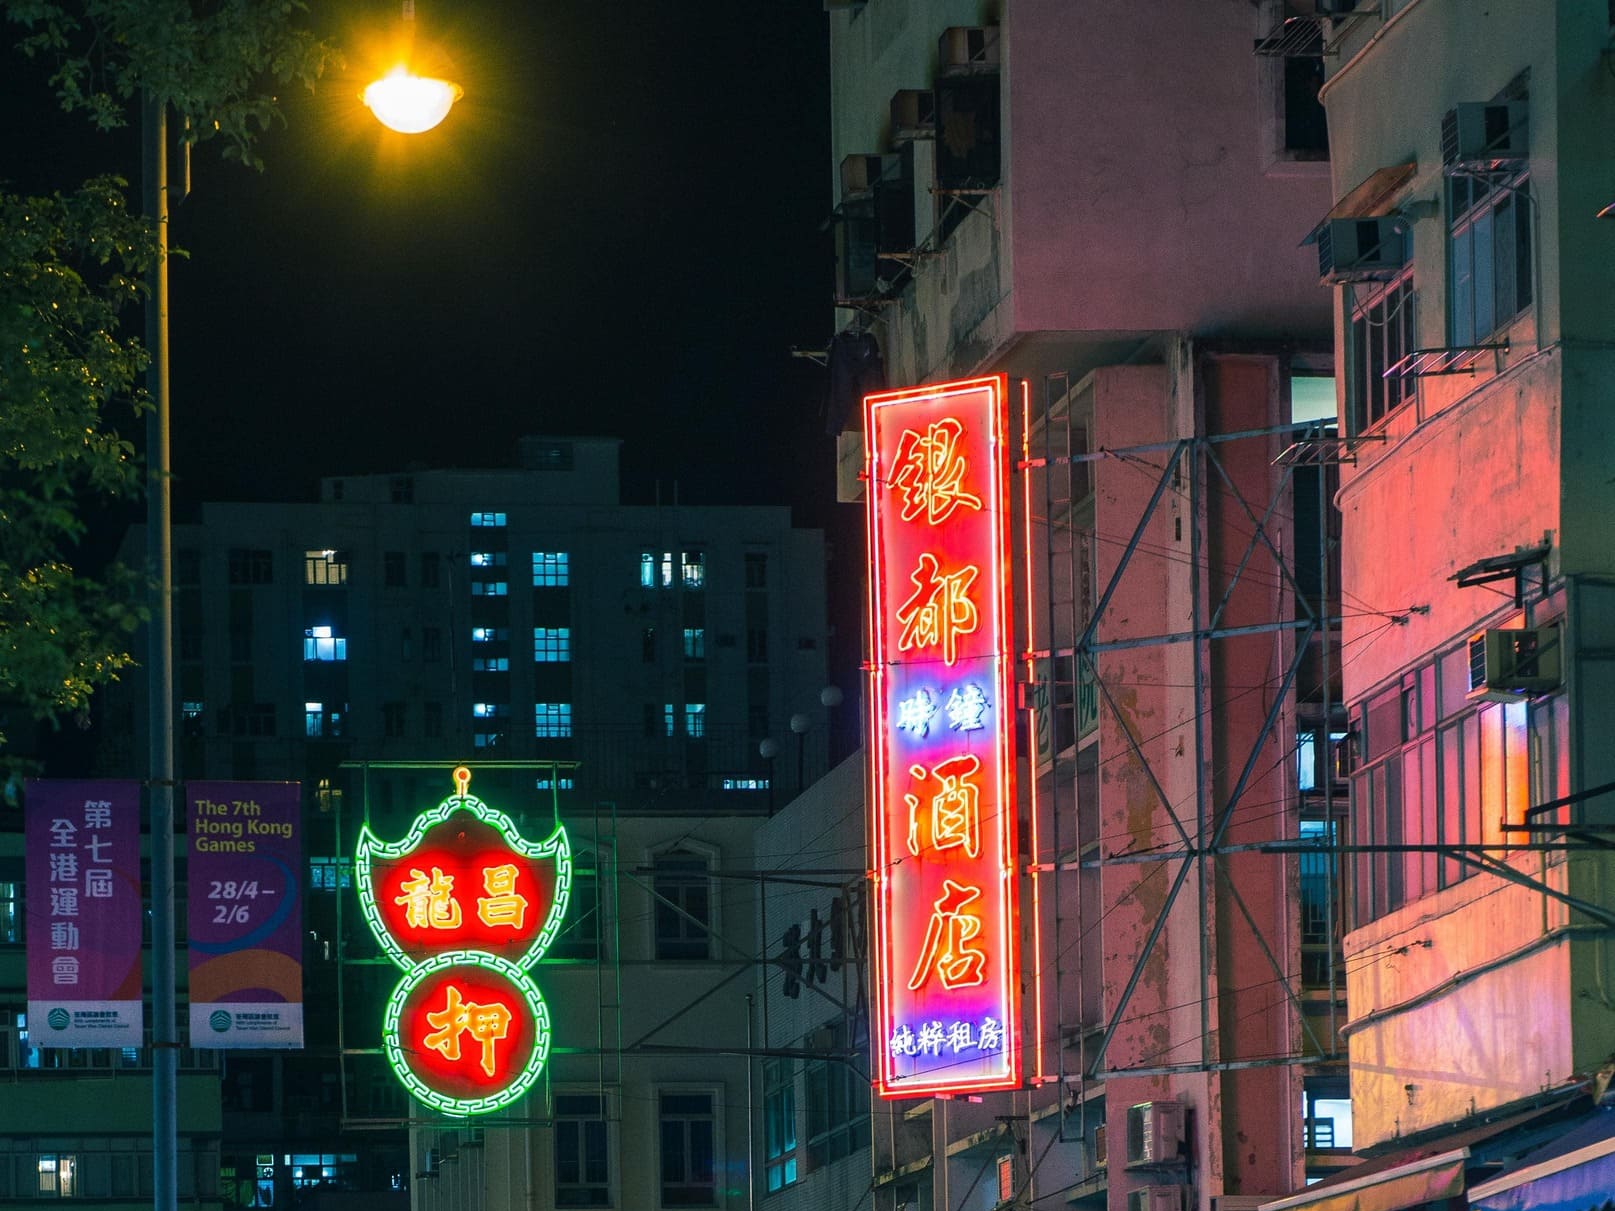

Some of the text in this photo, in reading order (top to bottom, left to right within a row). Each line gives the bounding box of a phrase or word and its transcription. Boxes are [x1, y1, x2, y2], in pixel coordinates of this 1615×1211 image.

[195, 800, 262, 816] The 7th
[195, 819, 293, 839] Hong Kong
[84, 799, 114, 899] 第七屆
[195, 837, 256, 852] Games
[49, 818, 79, 985] 全港運動會
[213, 904, 250, 924] 2/6
[425, 984, 512, 1078] 押
